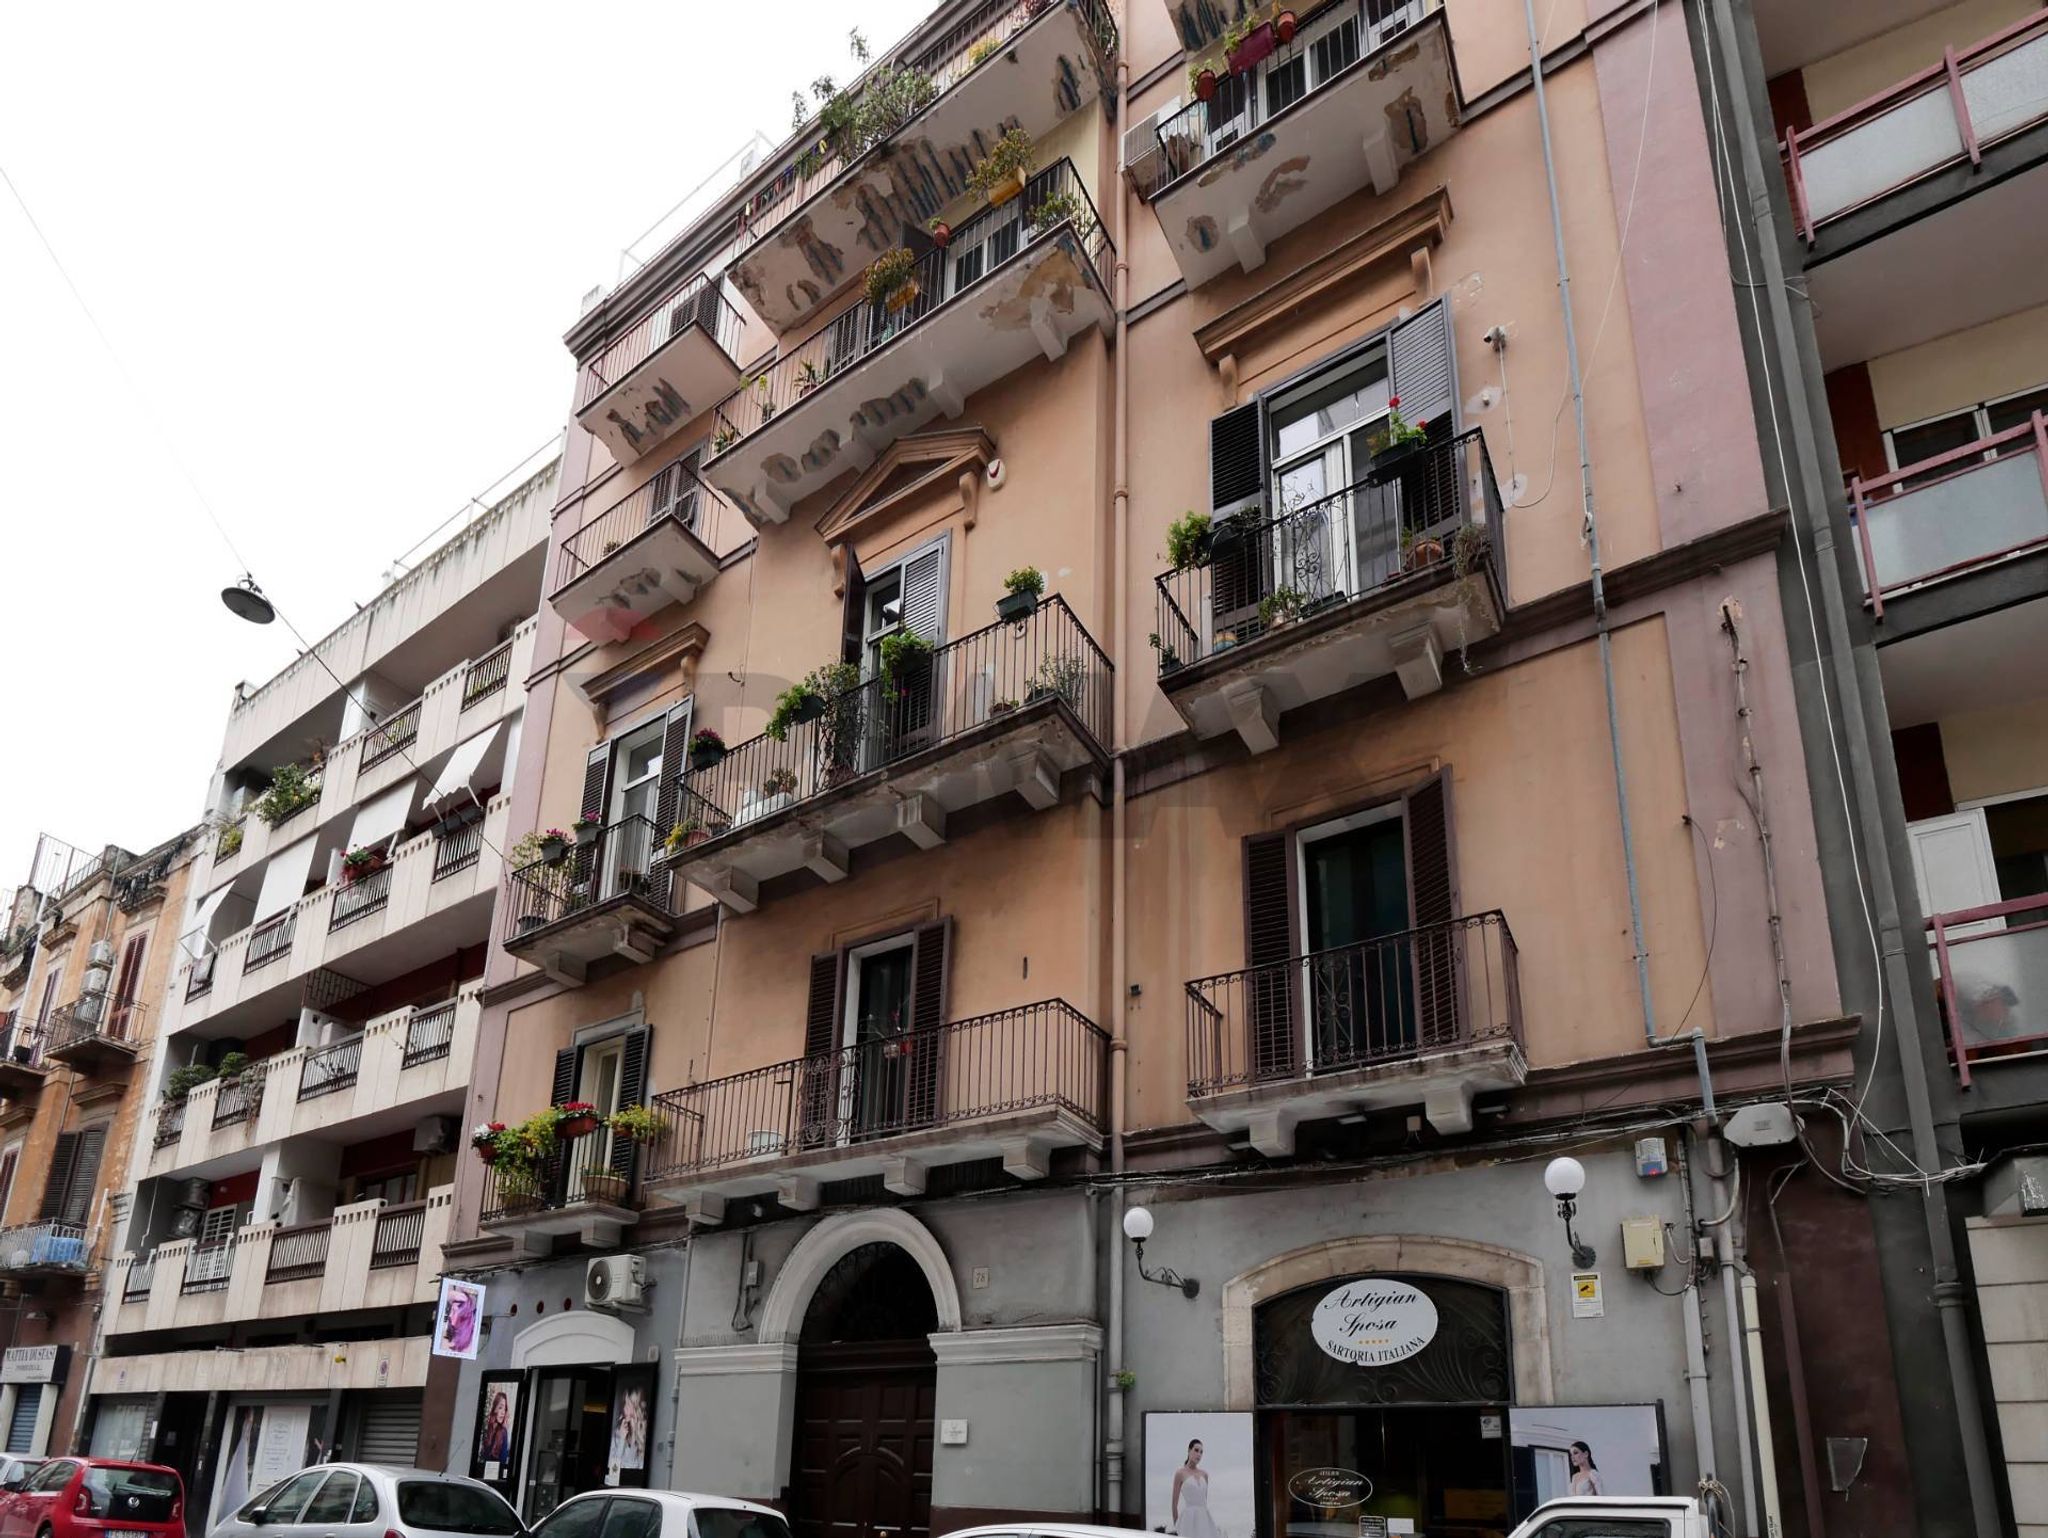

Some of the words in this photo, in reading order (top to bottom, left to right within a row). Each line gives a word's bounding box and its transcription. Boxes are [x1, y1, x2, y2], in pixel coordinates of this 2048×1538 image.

[1323, 1289, 1418, 1312] Artigian
[1339, 1312, 1398, 1337] Sposa
[1325, 1340, 1376, 1363] SARTORIA
[1378, 1336, 1426, 1362] ITALIANA
[1296, 1475, 1363, 1487] Artigian
[1309, 1486, 1351, 1499] Sposa
